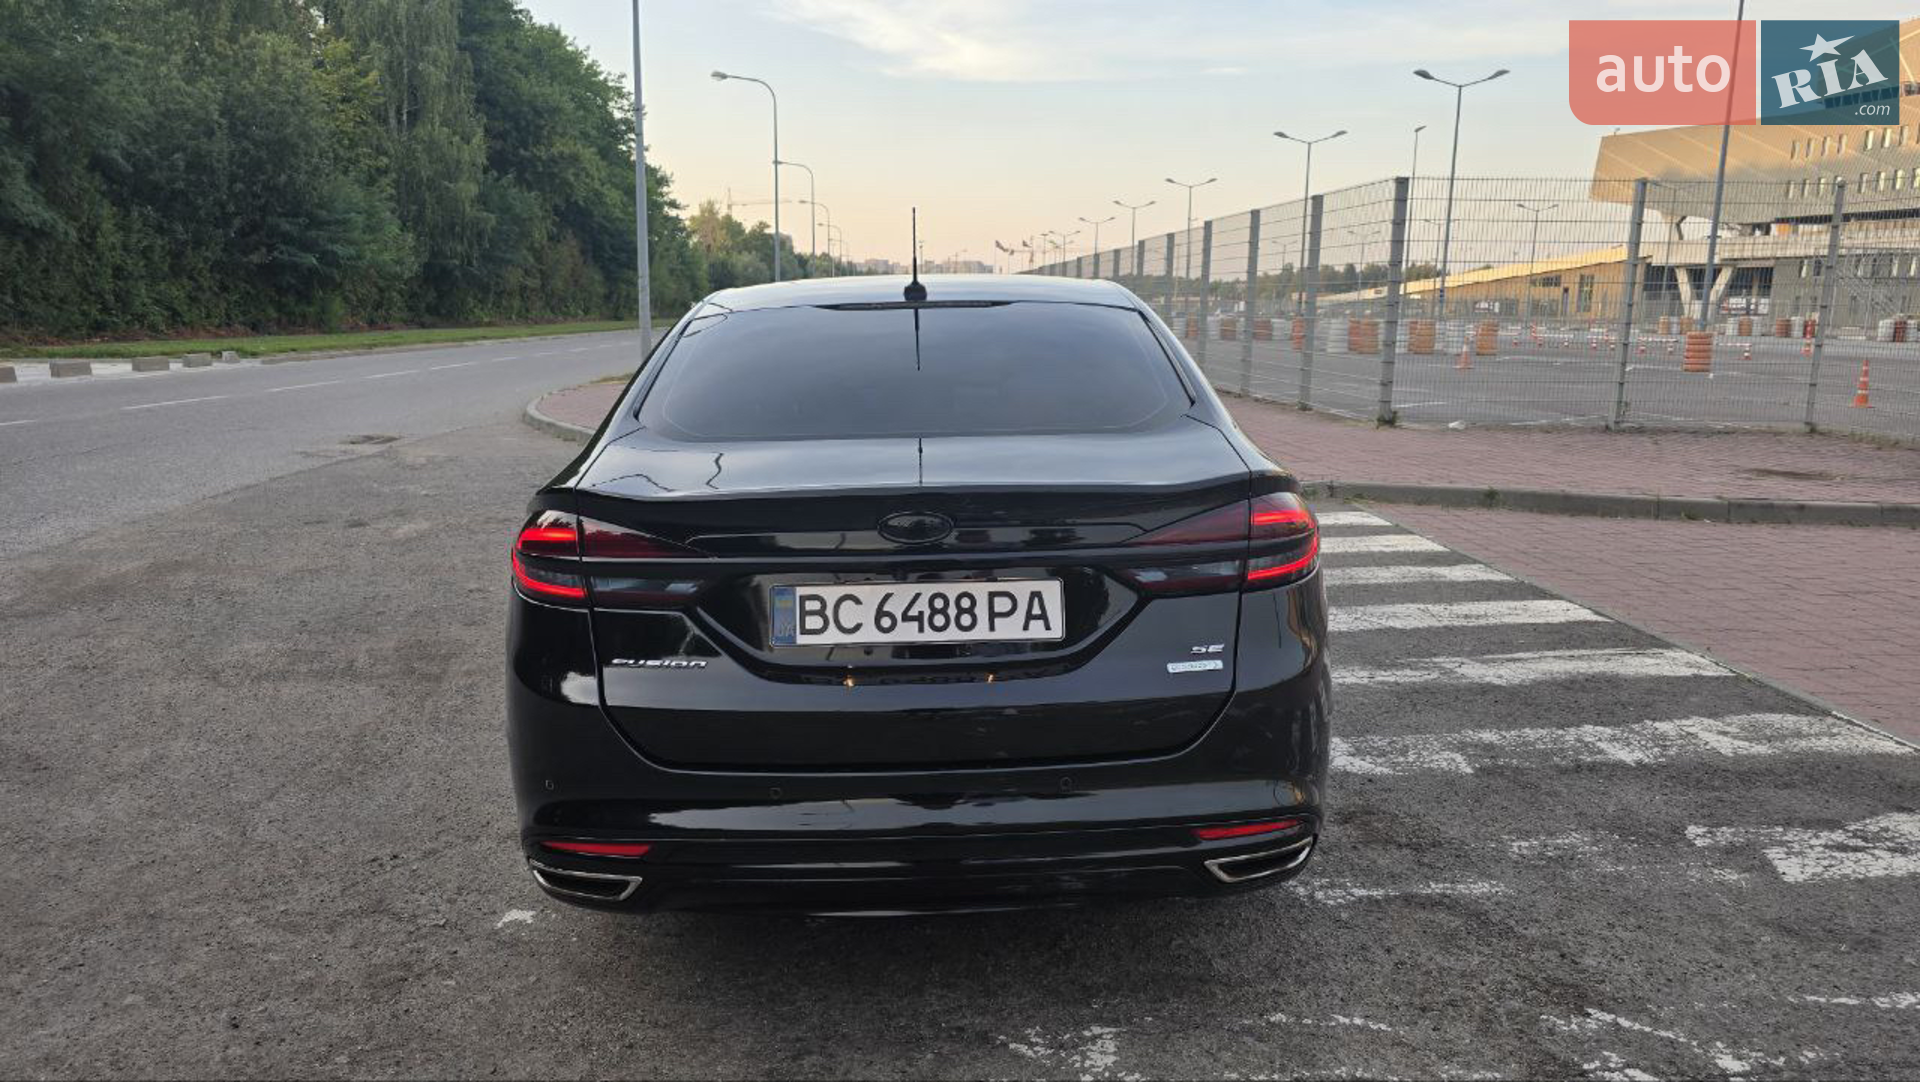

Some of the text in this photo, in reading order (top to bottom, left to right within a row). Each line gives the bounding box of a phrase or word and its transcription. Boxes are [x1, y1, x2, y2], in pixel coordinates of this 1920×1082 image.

[799, 590, 1052, 636] BC 6488 PA
